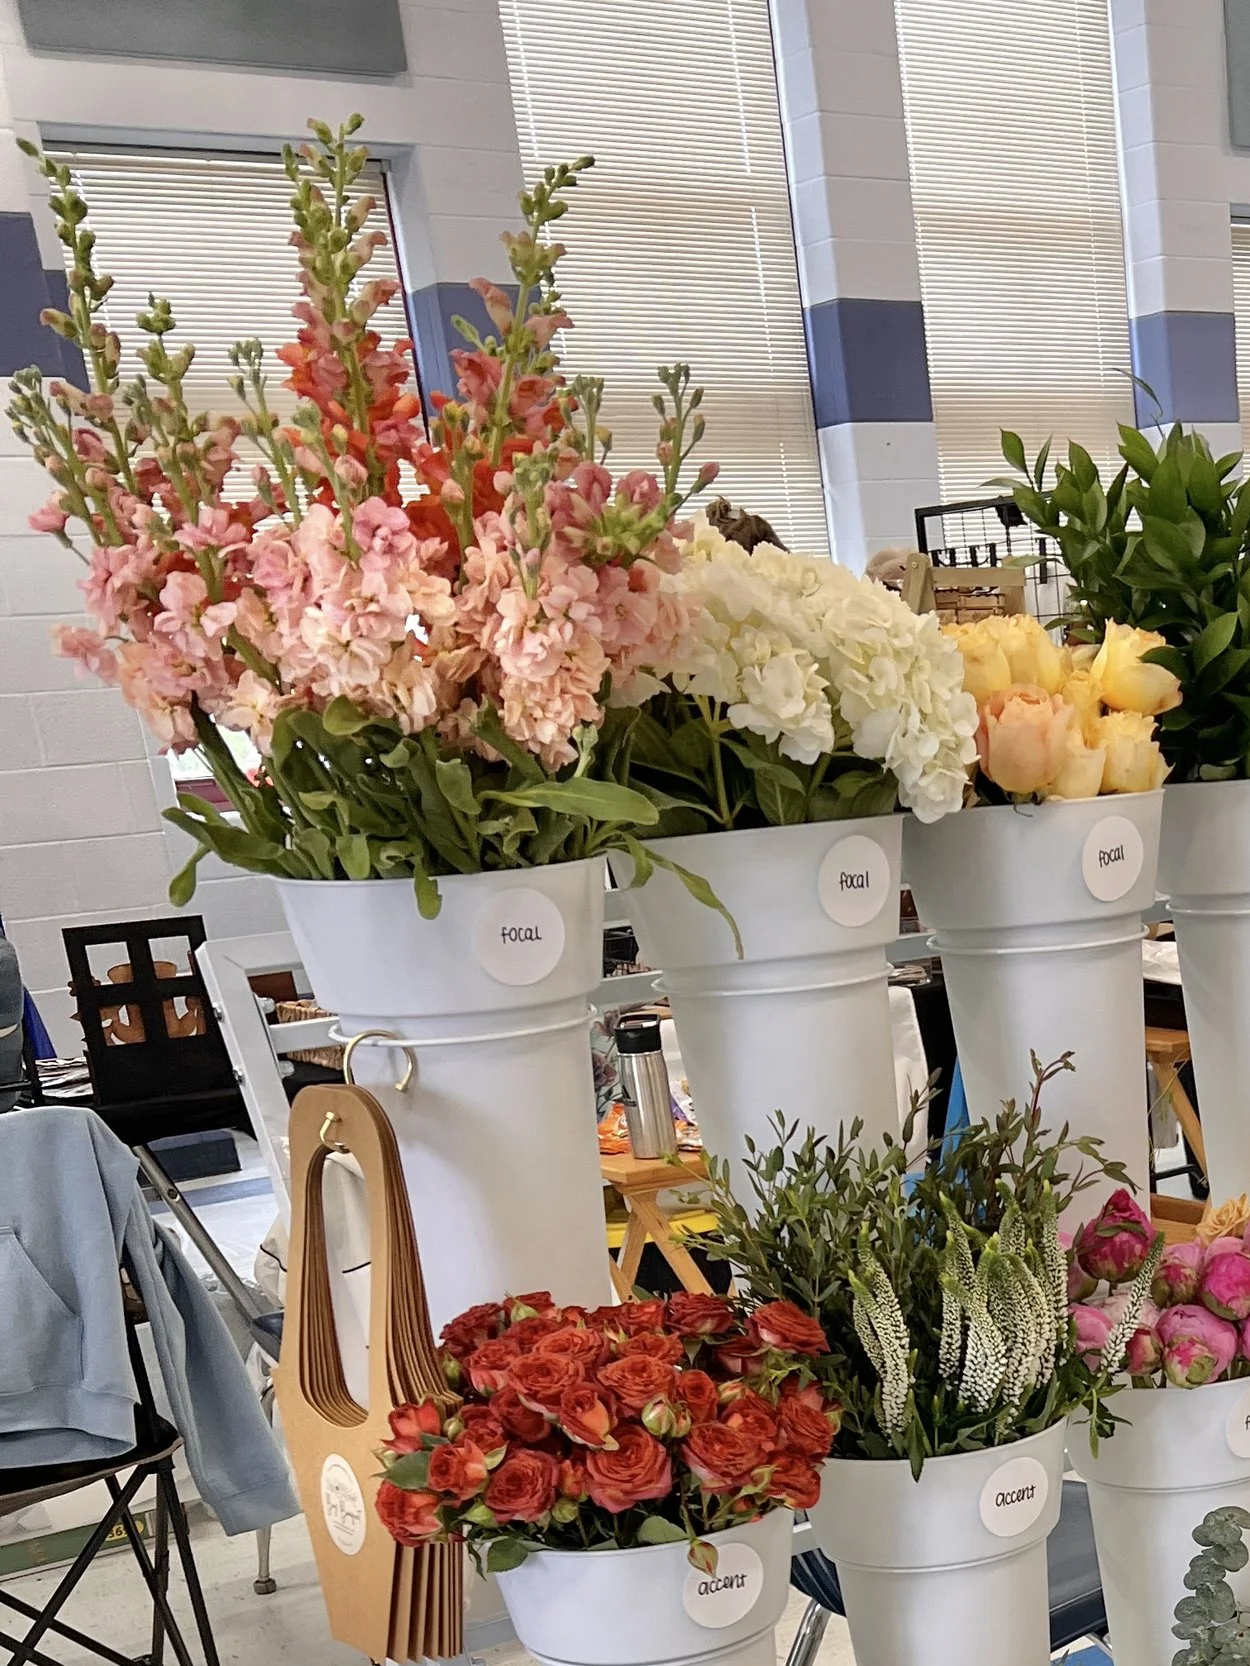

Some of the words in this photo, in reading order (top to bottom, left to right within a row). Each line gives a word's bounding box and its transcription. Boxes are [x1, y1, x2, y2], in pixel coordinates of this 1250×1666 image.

[1098, 844, 1125, 868] focal
[839, 870, 870, 892] focal
[995, 1484, 1037, 1508] accent
[698, 1573, 748, 1596] accent
